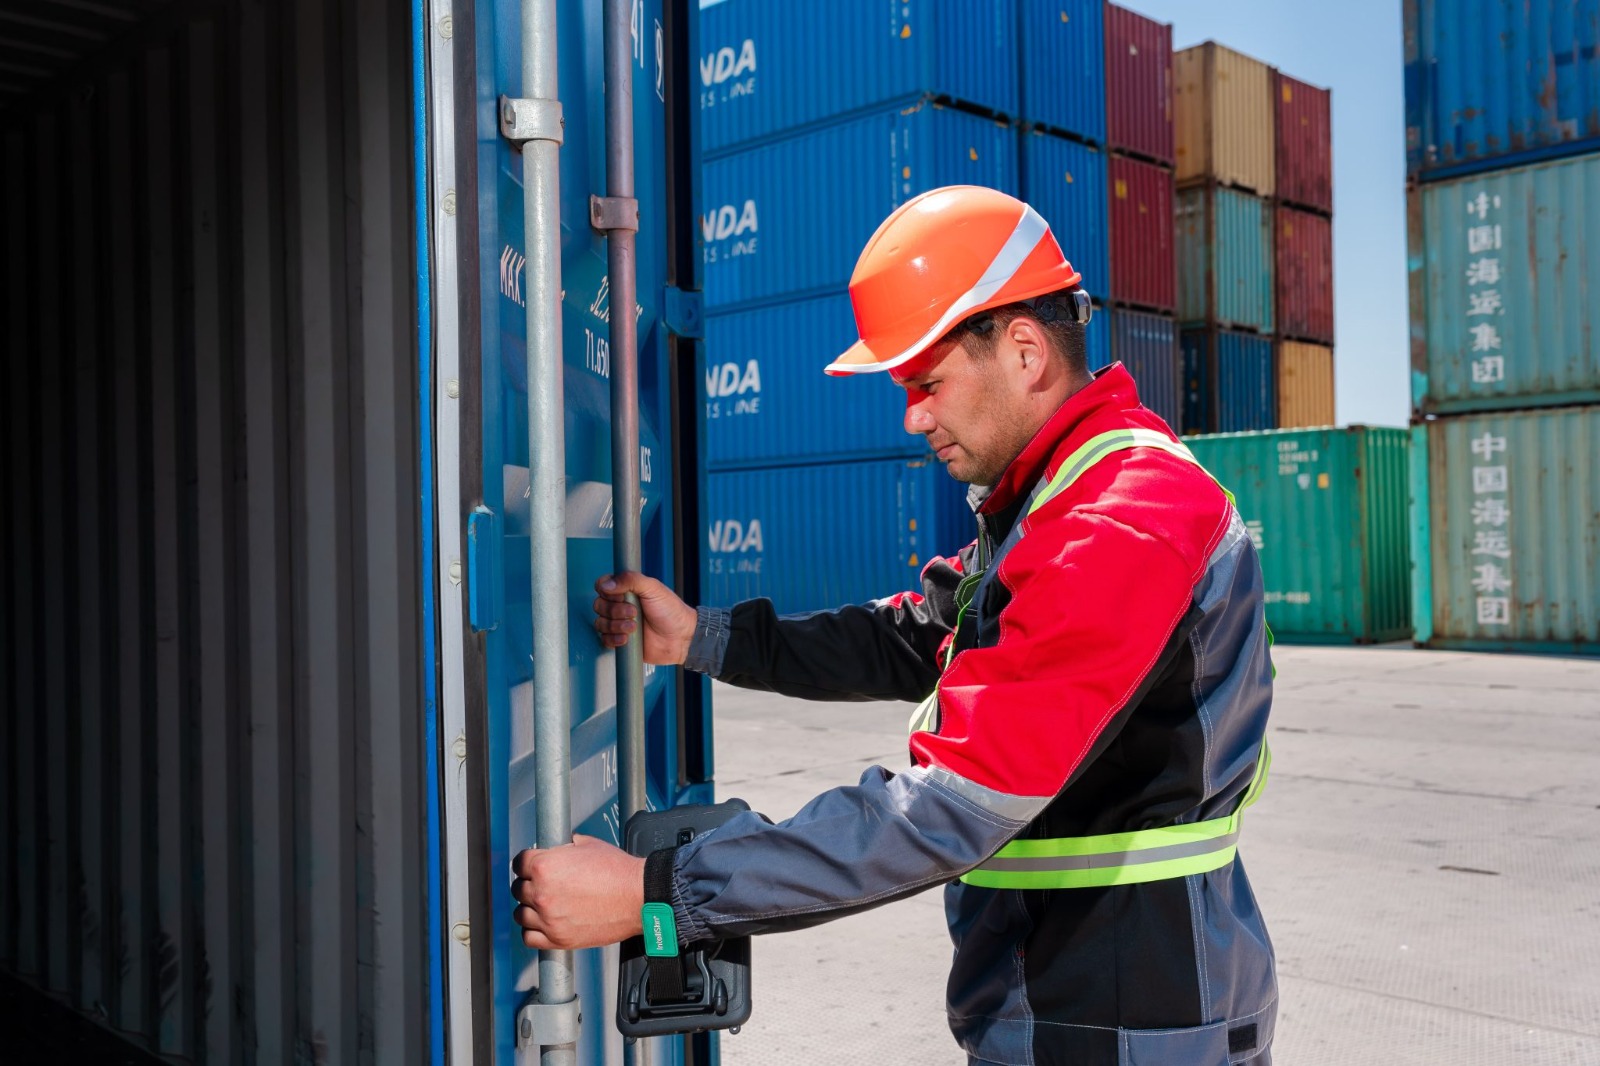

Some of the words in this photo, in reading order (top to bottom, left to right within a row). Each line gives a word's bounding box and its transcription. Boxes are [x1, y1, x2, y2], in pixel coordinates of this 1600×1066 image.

[501, 244, 526, 309] MAX.
[585, 328, 610, 379] 71.650
[1470, 431, 1512, 625] 中国海运集团
